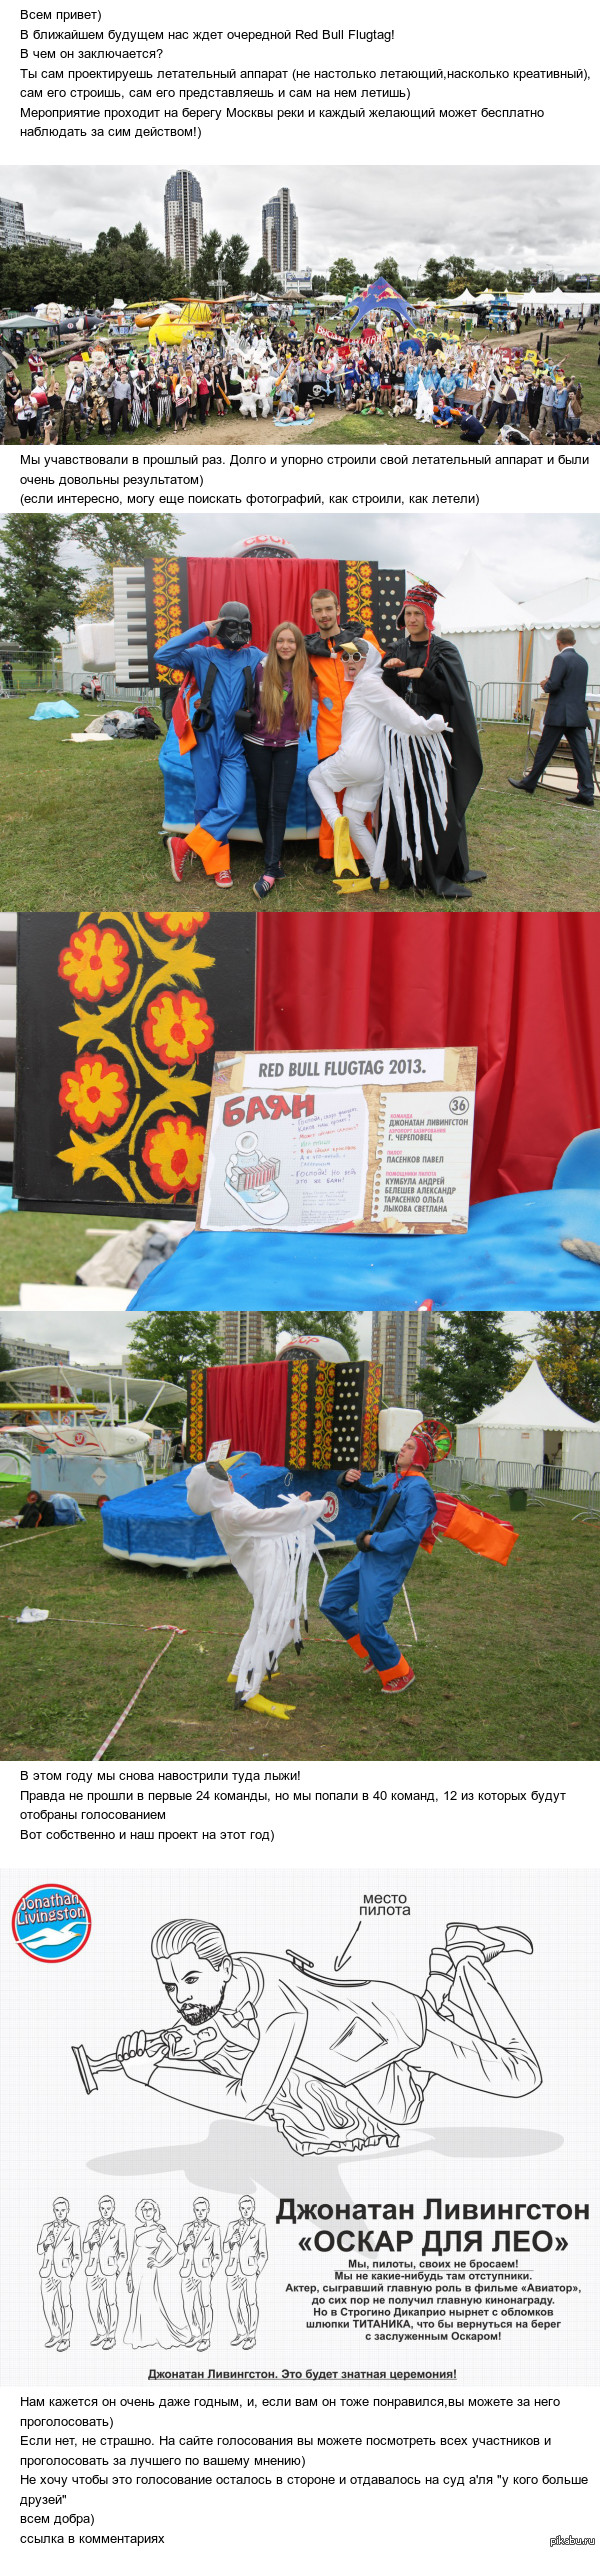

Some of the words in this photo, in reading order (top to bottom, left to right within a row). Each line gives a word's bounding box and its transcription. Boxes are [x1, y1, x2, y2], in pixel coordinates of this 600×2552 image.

[258, 1062, 284, 1078] RED
[288, 1061, 321, 1077] BULL
[324, 1060, 385, 1077] FLUGTAG
[388, 1058, 427, 1075] 2013.
[222, 1093, 316, 1128] БАЯН
[452, 1099, 466, 1111] 36
[388, 1119, 424, 1127] ДЖОНАТАН
[426, 1118, 469, 1126] ЛИВИНГСТОН
[395, 1133, 433, 1141] ЧЕРЕПОВЕЦ
[418, 1176, 445, 1186] АНДРЕЙ
[416, 1187, 456, 1195] АЛЕКСАНДР
[20, 1893, 80, 1911] Jonathan
[363, 1894, 408, 1904] место
[16, 1907, 86, 1926] Livingston
[359, 1906, 411, 1916] пилота
[275, 2197, 414, 2225] Джонатан
[423, 2198, 590, 2221] Ливингстон
[298, 2229, 414, 2253] «ОСКАР
[421, 2230, 483, 2257] ДЛЯ
[491, 2229, 569, 2253] ЛЕО»
[348, 2259, 370, 2270] Мы,
[372, 2261, 416, 2270] пилоты,
[419, 2261, 451, 2269] своих
[454, 2261, 467, 2269] не
[469, 2259, 519, 2271] бросаем!
[334, 2271, 353, 2280] Мы
[355, 2273, 369, 2281] не
[371, 2271, 444, 2283] какие-нибудь
[445, 2273, 466, 2281] там
[468, 2273, 533, 2283] отступники.
[285, 2283, 320, 2295] Актер,
[322, 2283, 384, 2294] сыгравший
[386, 2285, 433, 2295] главную
[435, 2285, 462, 2295] роль
[474, 2283, 518, 2294] фильме
[521, 2283, 582, 2295] «Авиатор»,
[311, 2297, 326, 2306] до
[328, 2297, 347, 2305] сих
[350, 2297, 370, 2307] пор
[372, 2297, 386, 2305] не
[388, 2297, 434, 2307] получил
[436, 2297, 483, 2307] главную
[485, 2297, 555, 2307] кинонаграду.
[313, 2307, 328, 2317] Но
[330, 2309, 338, 2317] в
[340, 2307, 391, 2319] Строгино
[393, 2307, 446, 2319] Дикаприо
[449, 2309, 490, 2319] нырнет
[491, 2309, 498, 2317] с
[500, 2307, 554, 2317] обломков
[306, 2321, 350, 2329] шлюпки
[352, 2319, 414, 2330] ТИТАНИКА,
[416, 2321, 435, 2329] что
[437, 2319, 454, 2329] бы
[456, 2321, 513, 2331] вернуться
[515, 2321, 528, 2329] на
[530, 2319, 562, 2331] берег
[365, 2333, 372, 2341] с
[374, 2333, 448, 2343] заслуженным
[451, 2331, 502, 2343] Оскаром!
[147, 2368, 205, 2379] Джонатан
[207, 2368, 278, 2379] Ливингстон.
[281, 2368, 303, 2379] Это
[305, 2368, 339, 2379] будет
[341, 2371, 387, 2379] знатная
[389, 2369, 457, 2379] церемония!
